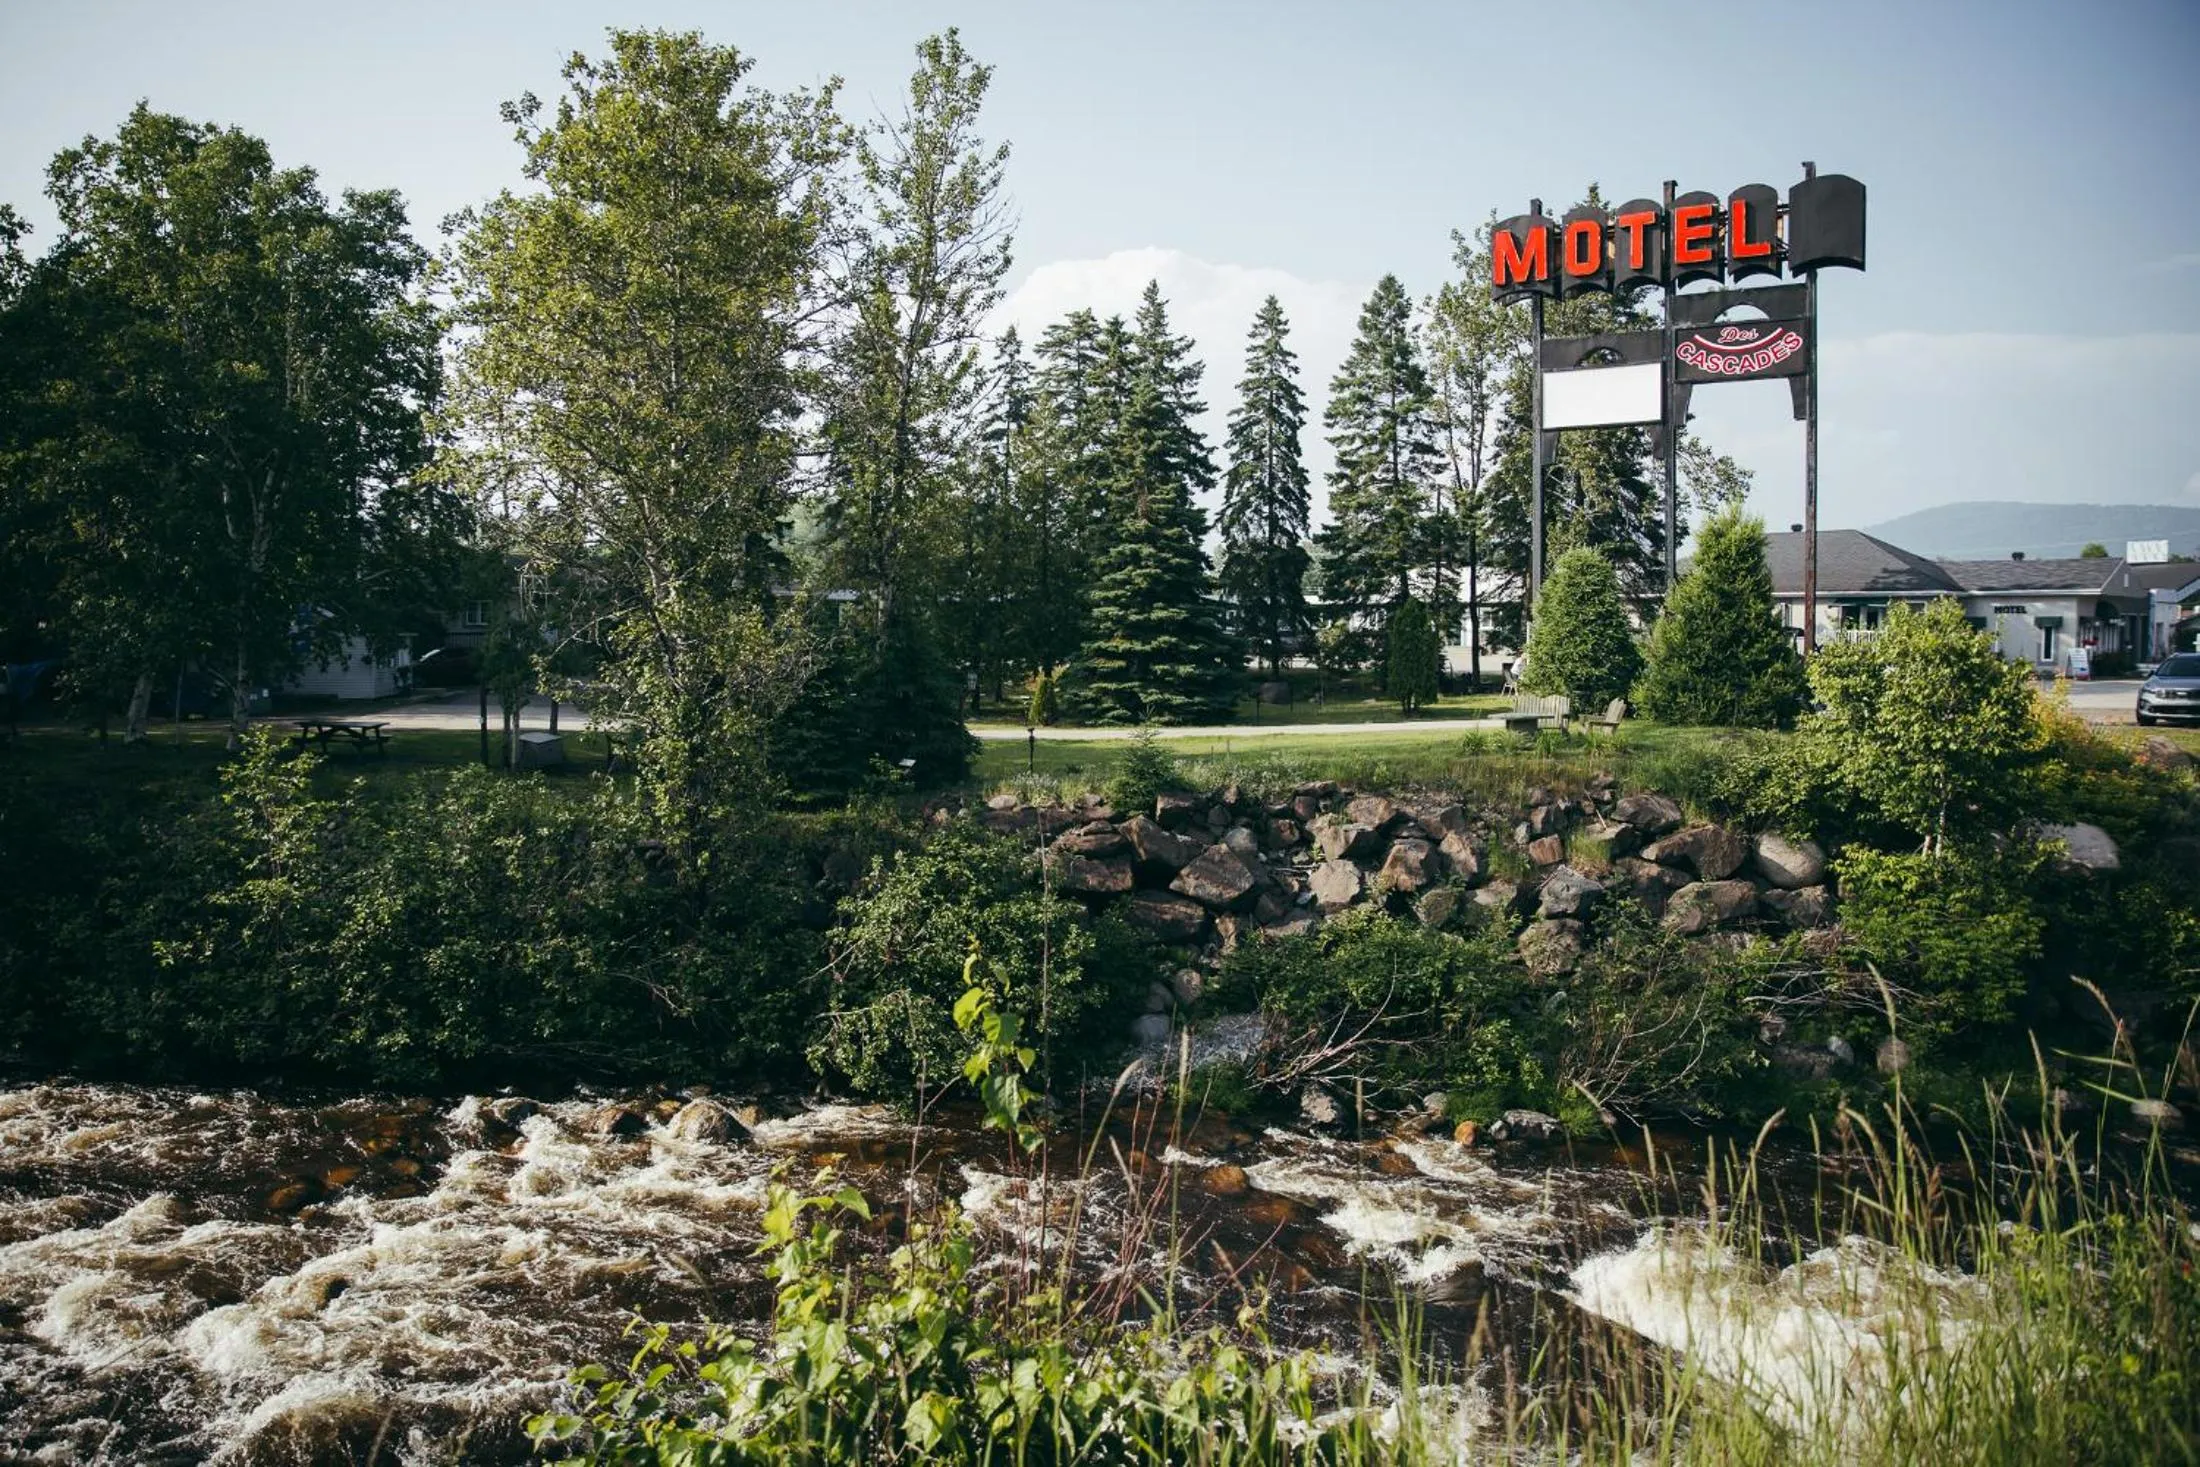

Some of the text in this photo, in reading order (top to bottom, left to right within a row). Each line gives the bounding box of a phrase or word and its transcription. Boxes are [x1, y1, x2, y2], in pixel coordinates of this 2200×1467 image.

[1493, 199, 1771, 285] MOTEL
[1718, 326, 1759, 343] Des
[1676, 332, 1803, 374] CASCADES
[1994, 605, 2027, 614] MOTEL
